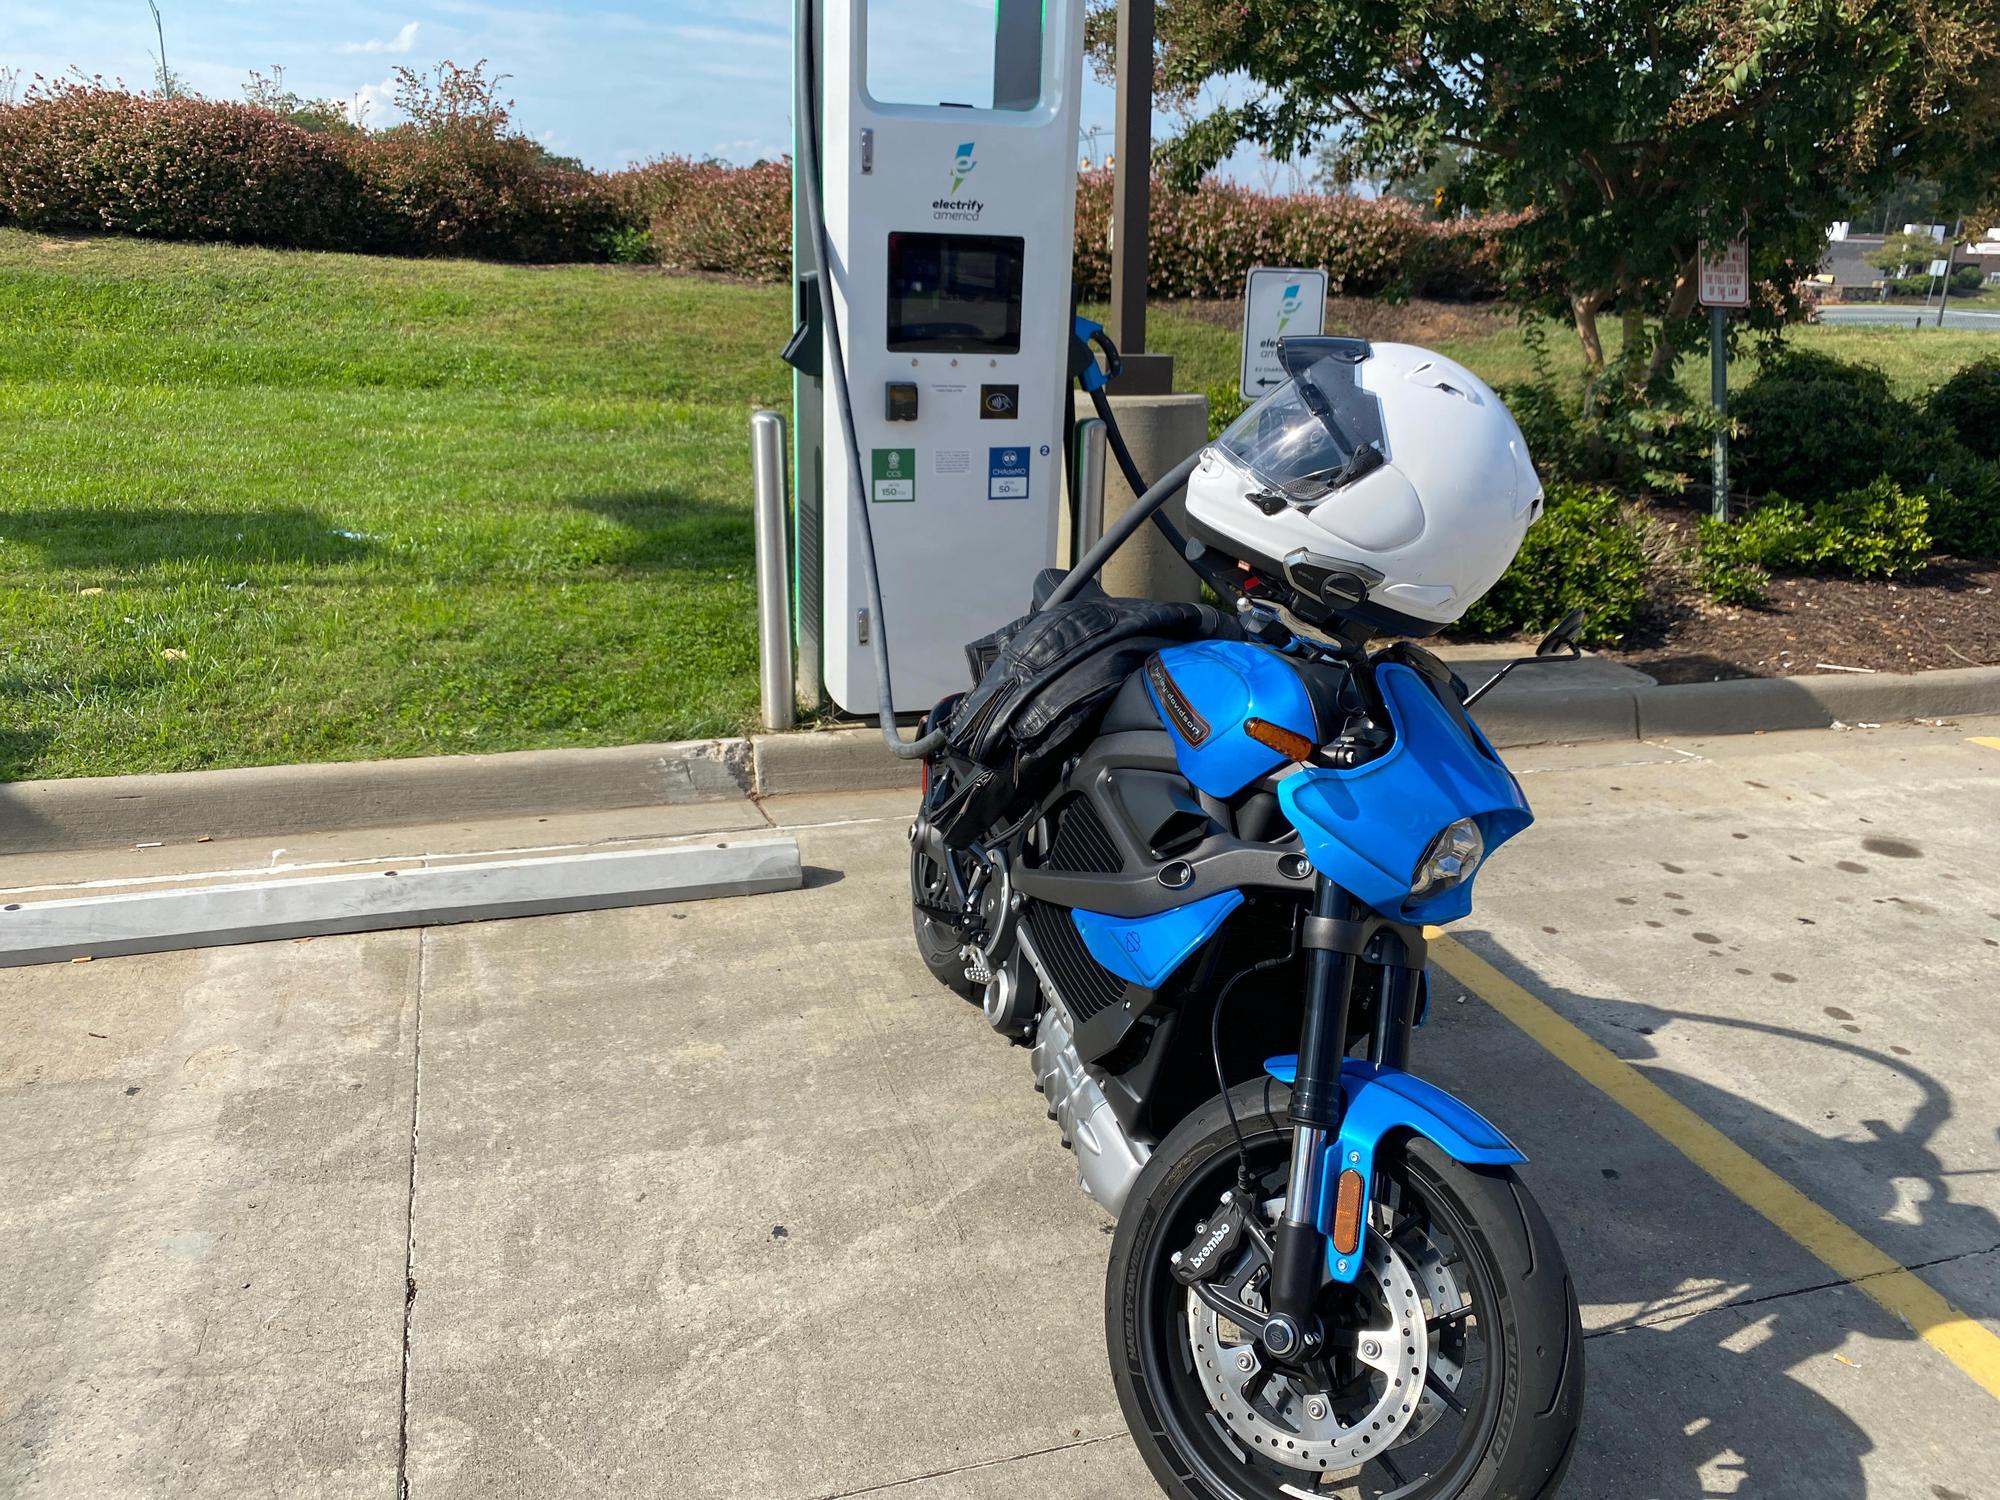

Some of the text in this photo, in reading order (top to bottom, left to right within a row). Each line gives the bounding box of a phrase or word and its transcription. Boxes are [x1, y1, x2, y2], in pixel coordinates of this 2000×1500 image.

[932, 198, 984, 213] electrify
[933, 211, 980, 222] america
[1041, 446, 1049, 455] 2
[886, 470, 902, 478] CCS
[882, 488, 897, 496] 150
[1000, 485, 1010, 493] 50
[1154, 665, 1200, 735] harley-davidson
[1190, 1223, 1230, 1269] brembo
[1125, 1216, 1151, 1361] HARLEY-DAVIDSON
[1493, 1333, 1518, 1457] MICHELIN
